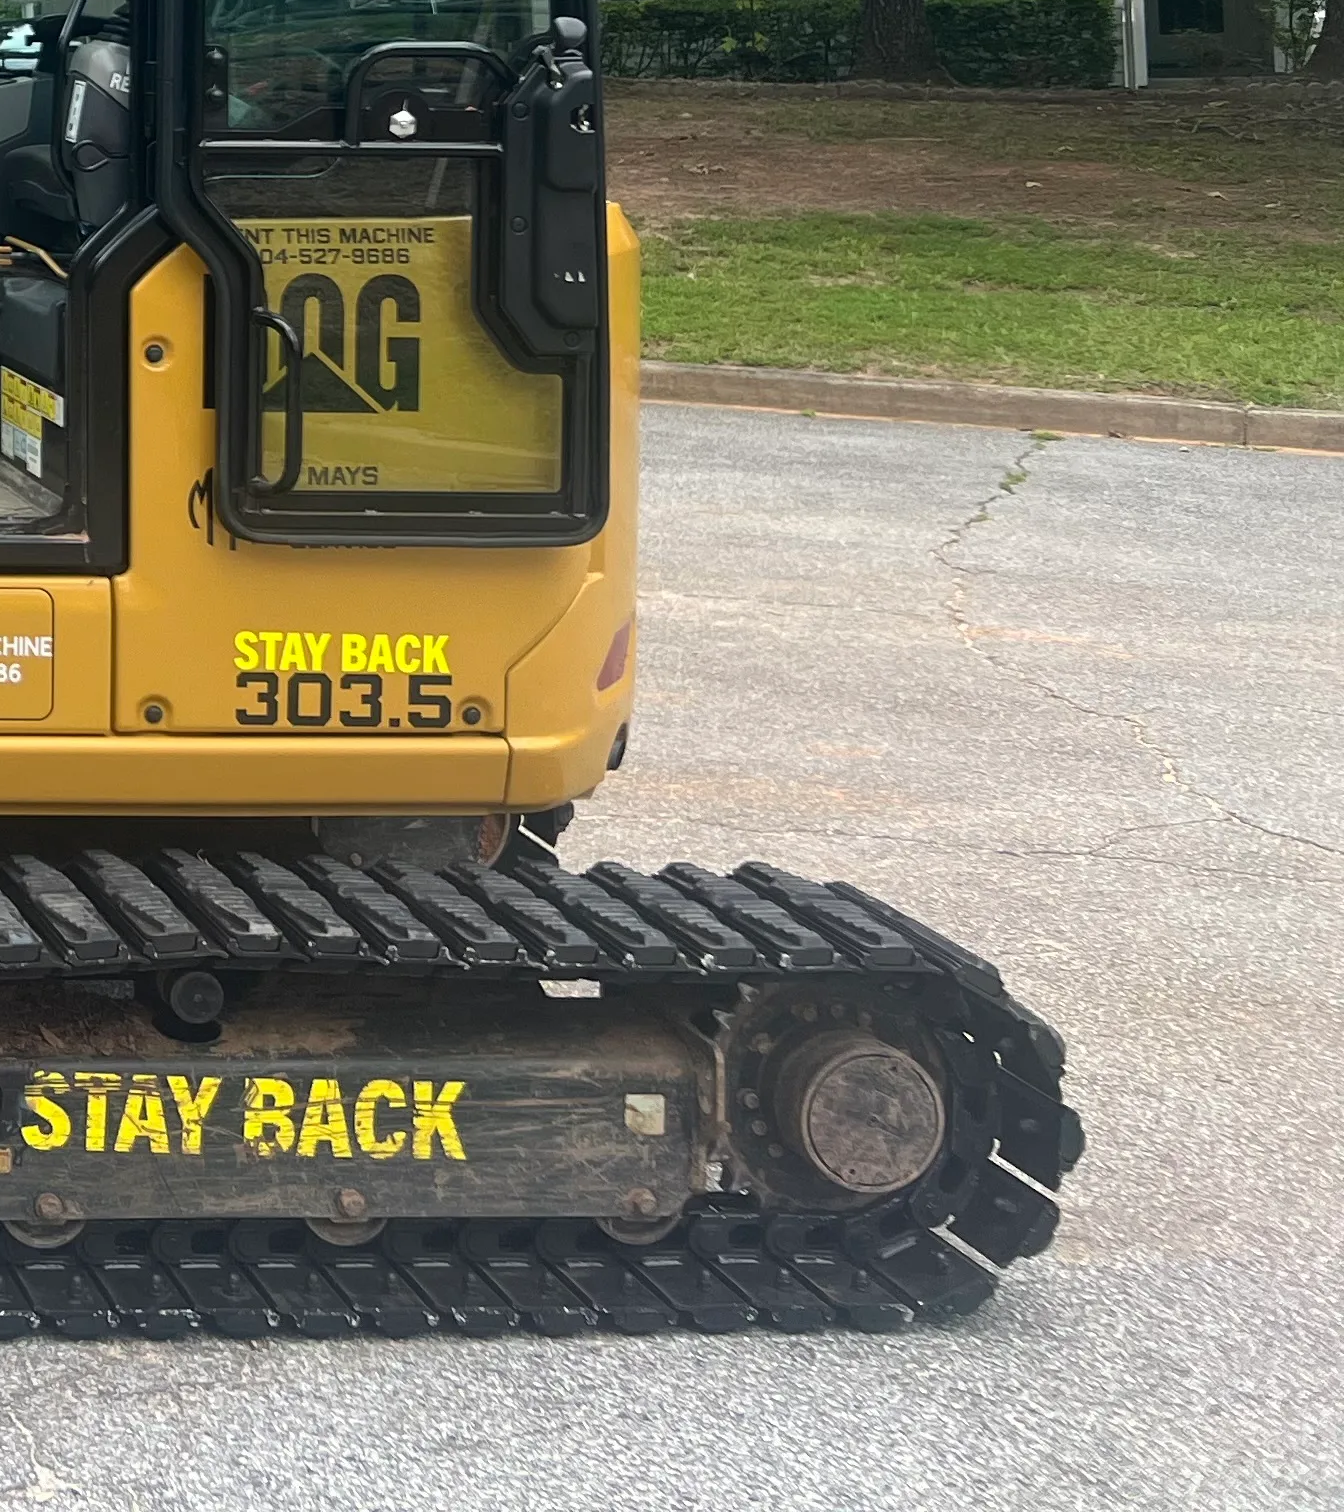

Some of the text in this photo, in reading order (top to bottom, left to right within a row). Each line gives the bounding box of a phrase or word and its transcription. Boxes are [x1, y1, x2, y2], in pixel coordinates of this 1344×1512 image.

[240, 226, 435, 245] NT THIS MACHINE
[259, 248, 411, 265] 04-527-9686
[203, 273, 421, 412] OG
[306, 465, 380, 486] MAYS
[233, 630, 451, 674] STAY BACK
[235, 671, 453, 729] 303.5
[20, 1070, 468, 1161] STAY BACK
